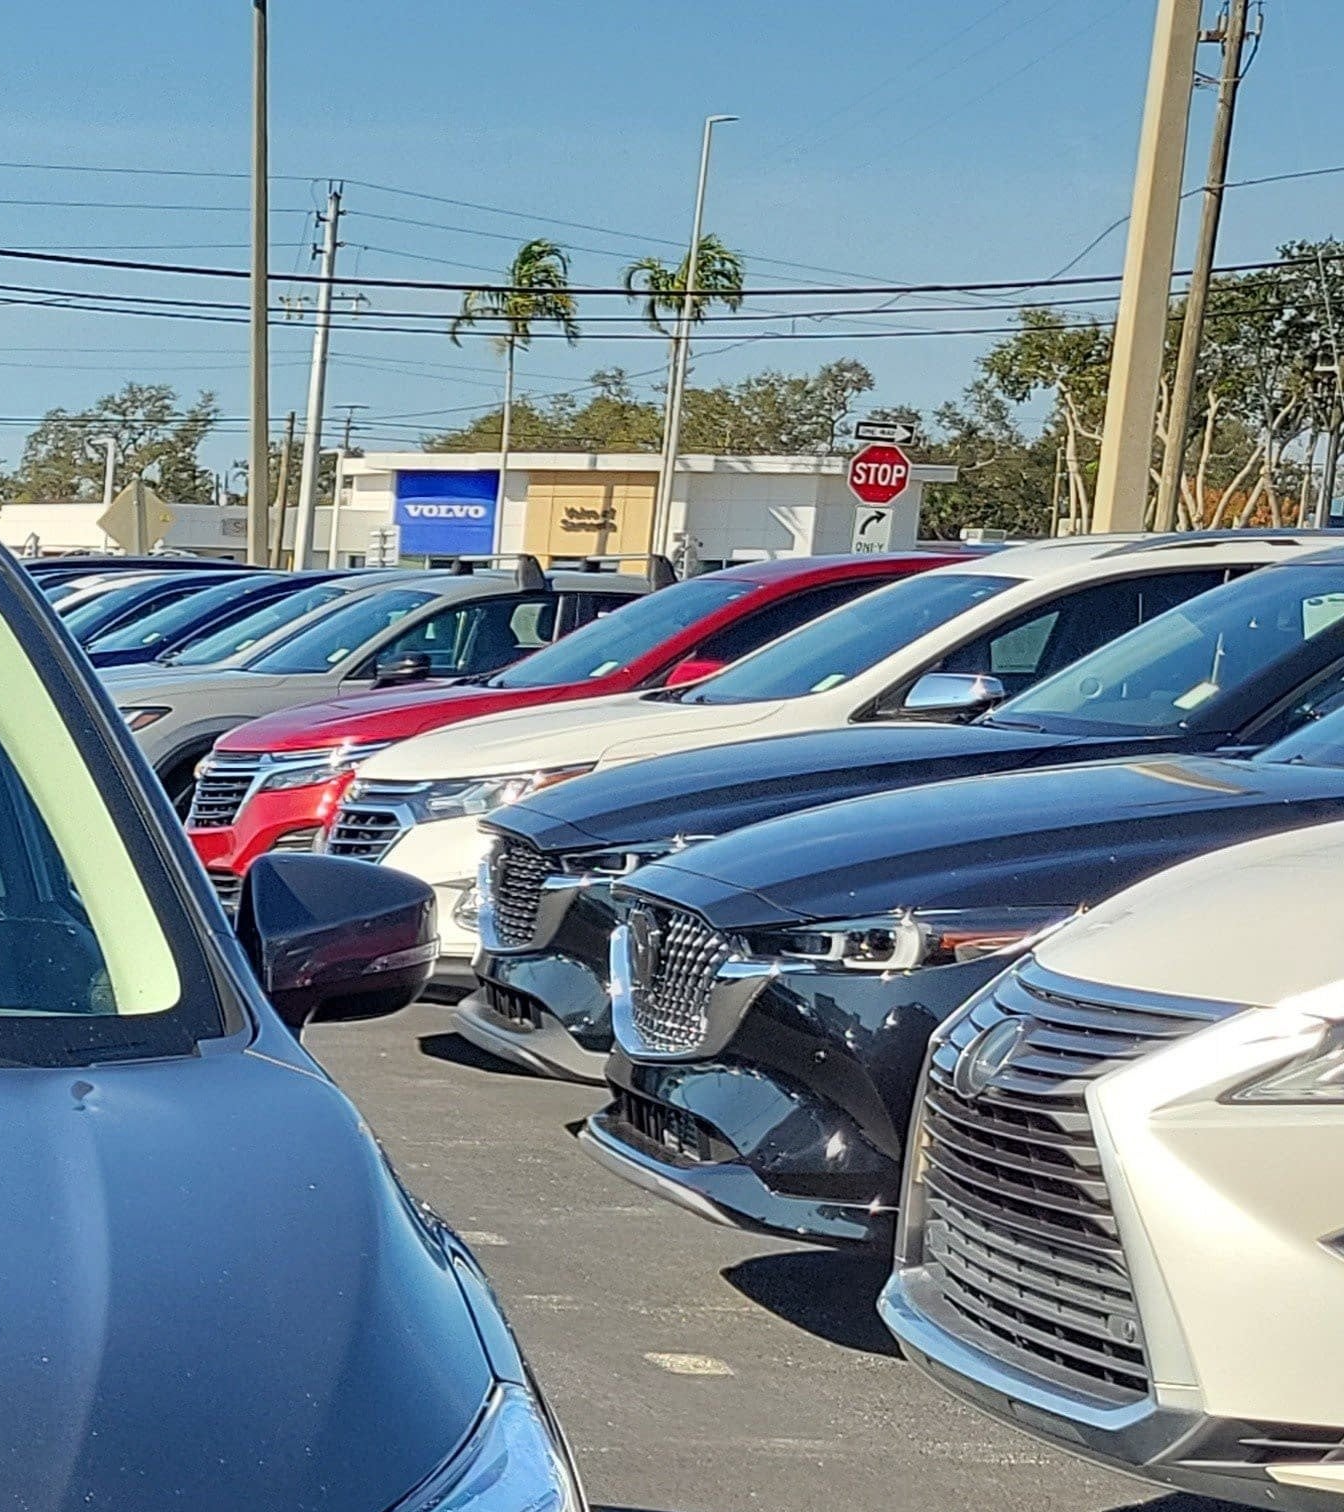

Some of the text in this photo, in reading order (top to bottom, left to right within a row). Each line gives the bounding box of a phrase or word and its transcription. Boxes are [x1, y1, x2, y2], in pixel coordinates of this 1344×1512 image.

[853, 462, 906, 487] STOP
[405, 504, 487, 519] VOLVO
[855, 541, 884, 552] ONLY
